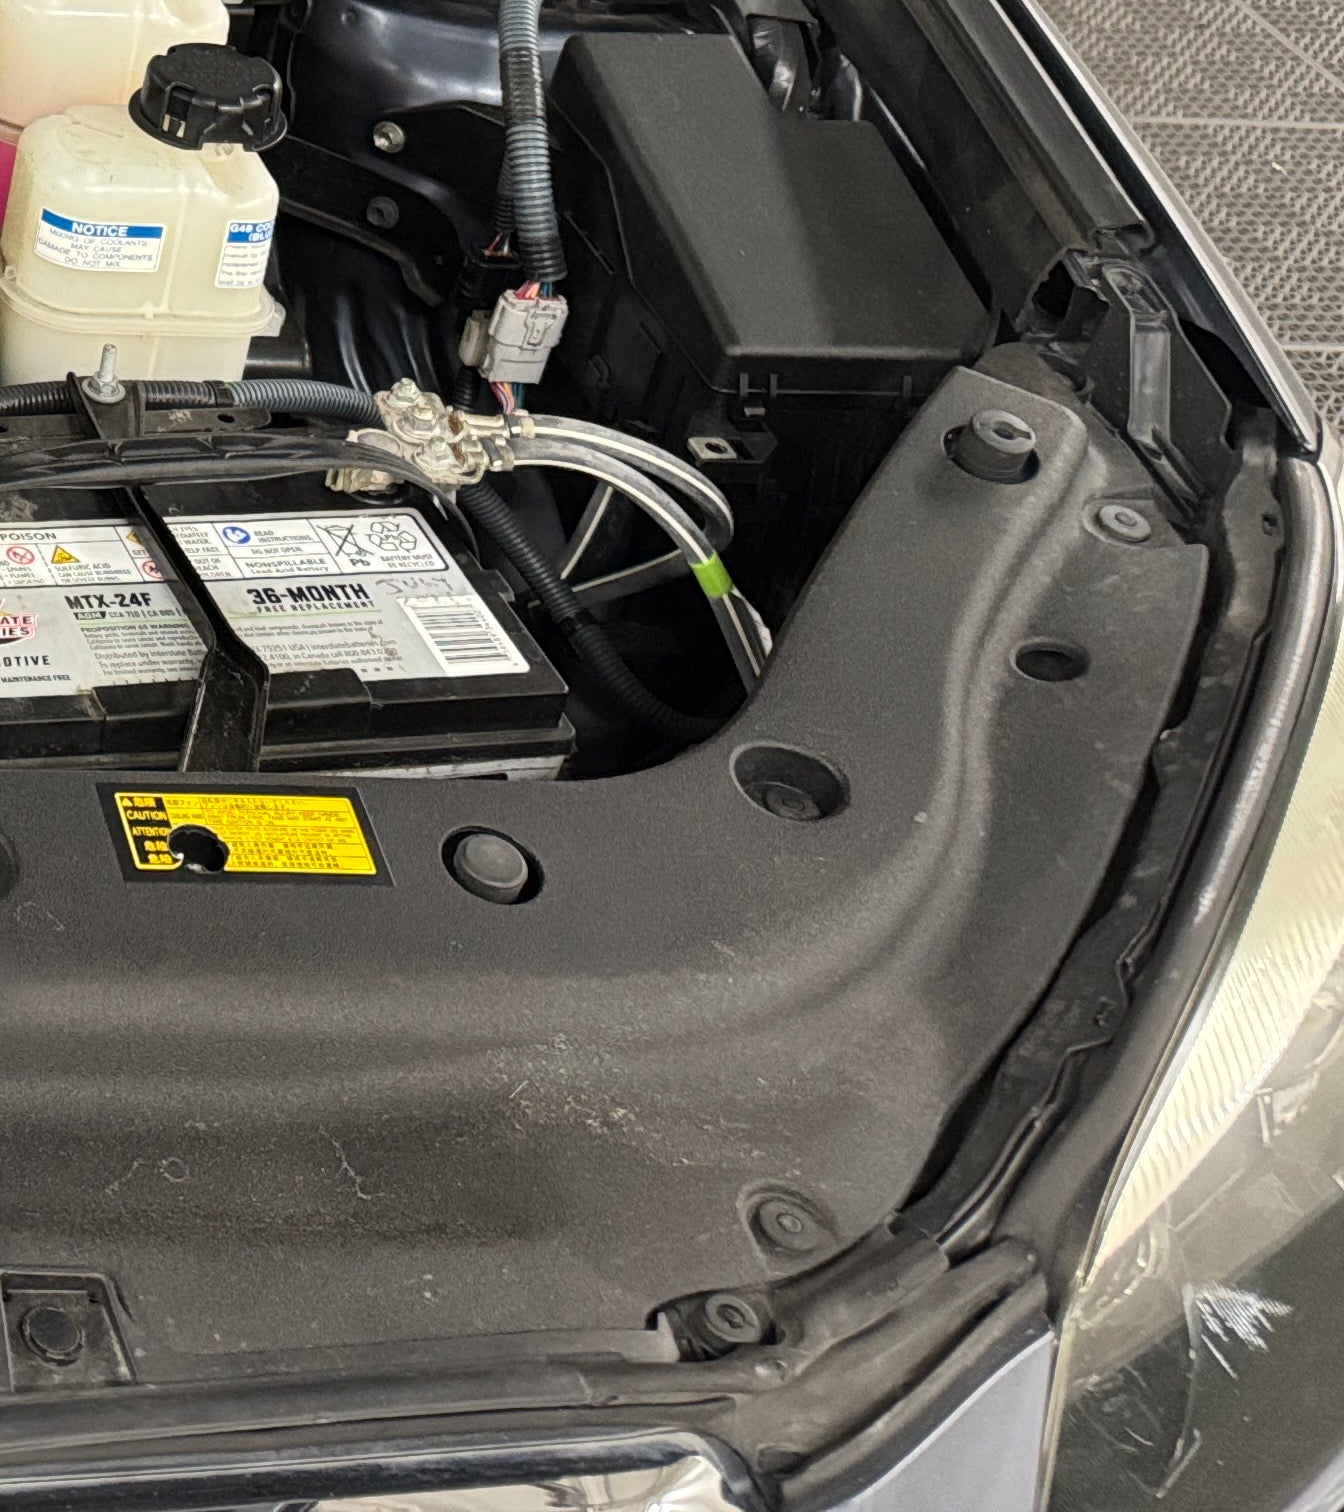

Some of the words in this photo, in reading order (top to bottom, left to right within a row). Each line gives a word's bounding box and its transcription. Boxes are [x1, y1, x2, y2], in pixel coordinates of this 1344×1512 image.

[71, 221, 129, 237] NOTICE
[38, 237, 72, 256] DAMAGE
[76, 250, 89, 259] TO
[92, 251, 154, 262] COMPONENTS
[70, 242, 90, 251] MAY
[93, 245, 123, 253] CAUSE
[64, 256, 79, 265] DO
[82, 258, 101, 267] NOT
[253, 529, 274, 537] READ
[244, 558, 327, 569] NONSPILLABLE
[349, 557, 372, 567] Pb
[379, 554, 411, 562] BATTERY
[276, 566, 295, 574] Acid
[246, 583, 371, 605] 36-MONTH
[64, 592, 152, 610] MTX-24F
[257, 603, 287, 614] FREE
[292, 600, 376, 612] REPLACEMENT
[146, 609, 159, 617] CA
[263, 644, 288, 653] 75251
[289, 643, 306, 652] USA
[93, 651, 138, 661] Distributed
[138, 650, 150, 659] by
[300, 651, 330, 660] Canada
[330, 650, 344, 658] call
[109, 660, 138, 669] replace
[1, 674, 52, 684] MAINTENANCE
[52, 674, 72, 682] FREE
[126, 809, 168, 821] CAUTION
